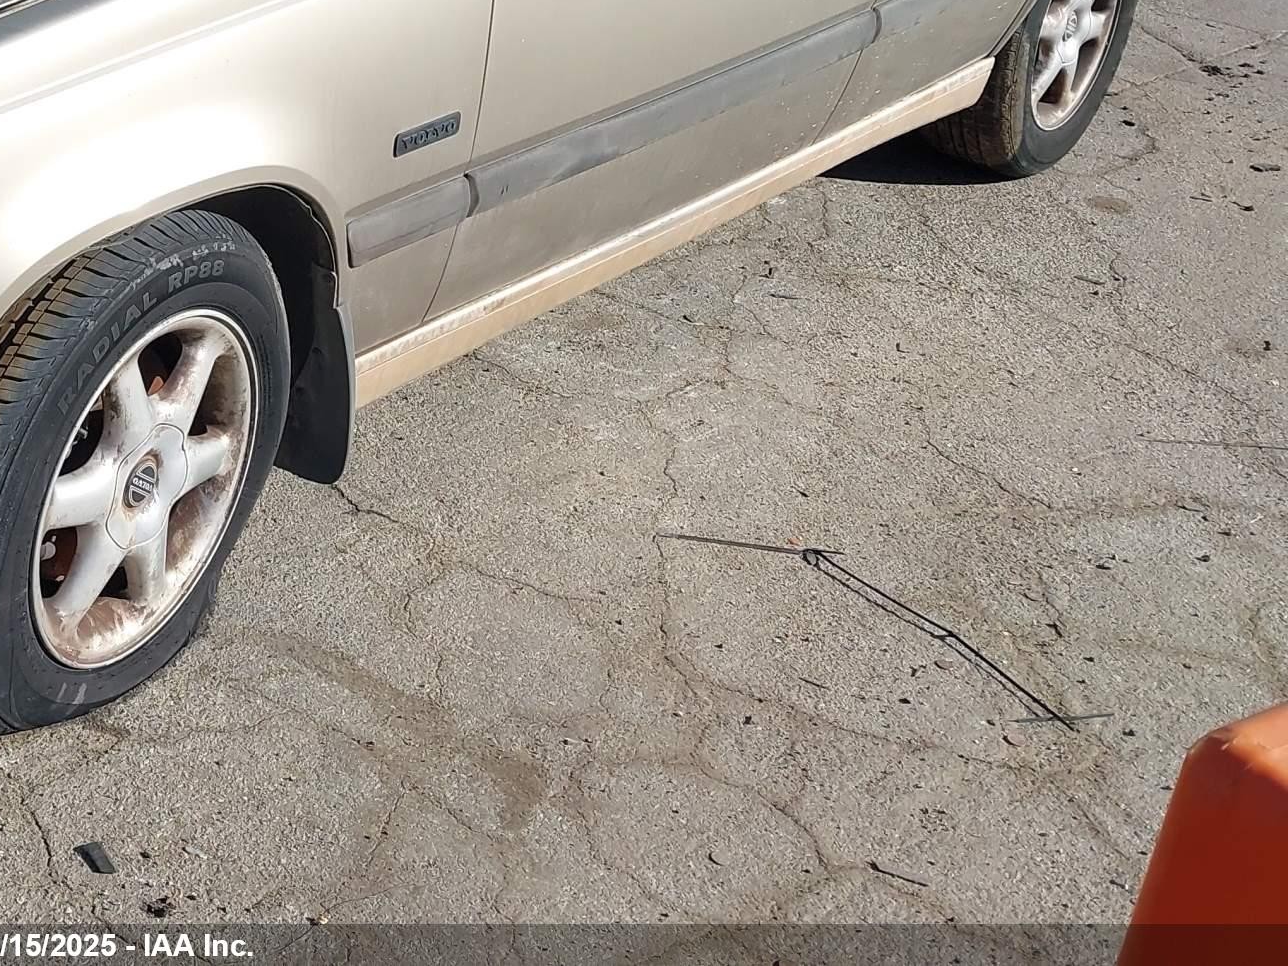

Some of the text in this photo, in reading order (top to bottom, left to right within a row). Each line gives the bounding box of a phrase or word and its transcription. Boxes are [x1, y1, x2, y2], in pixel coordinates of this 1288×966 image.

[400, 119, 456, 150] VOLVO
[57, 292, 158, 416] RADIAL
[167, 259, 225, 294] RP88
